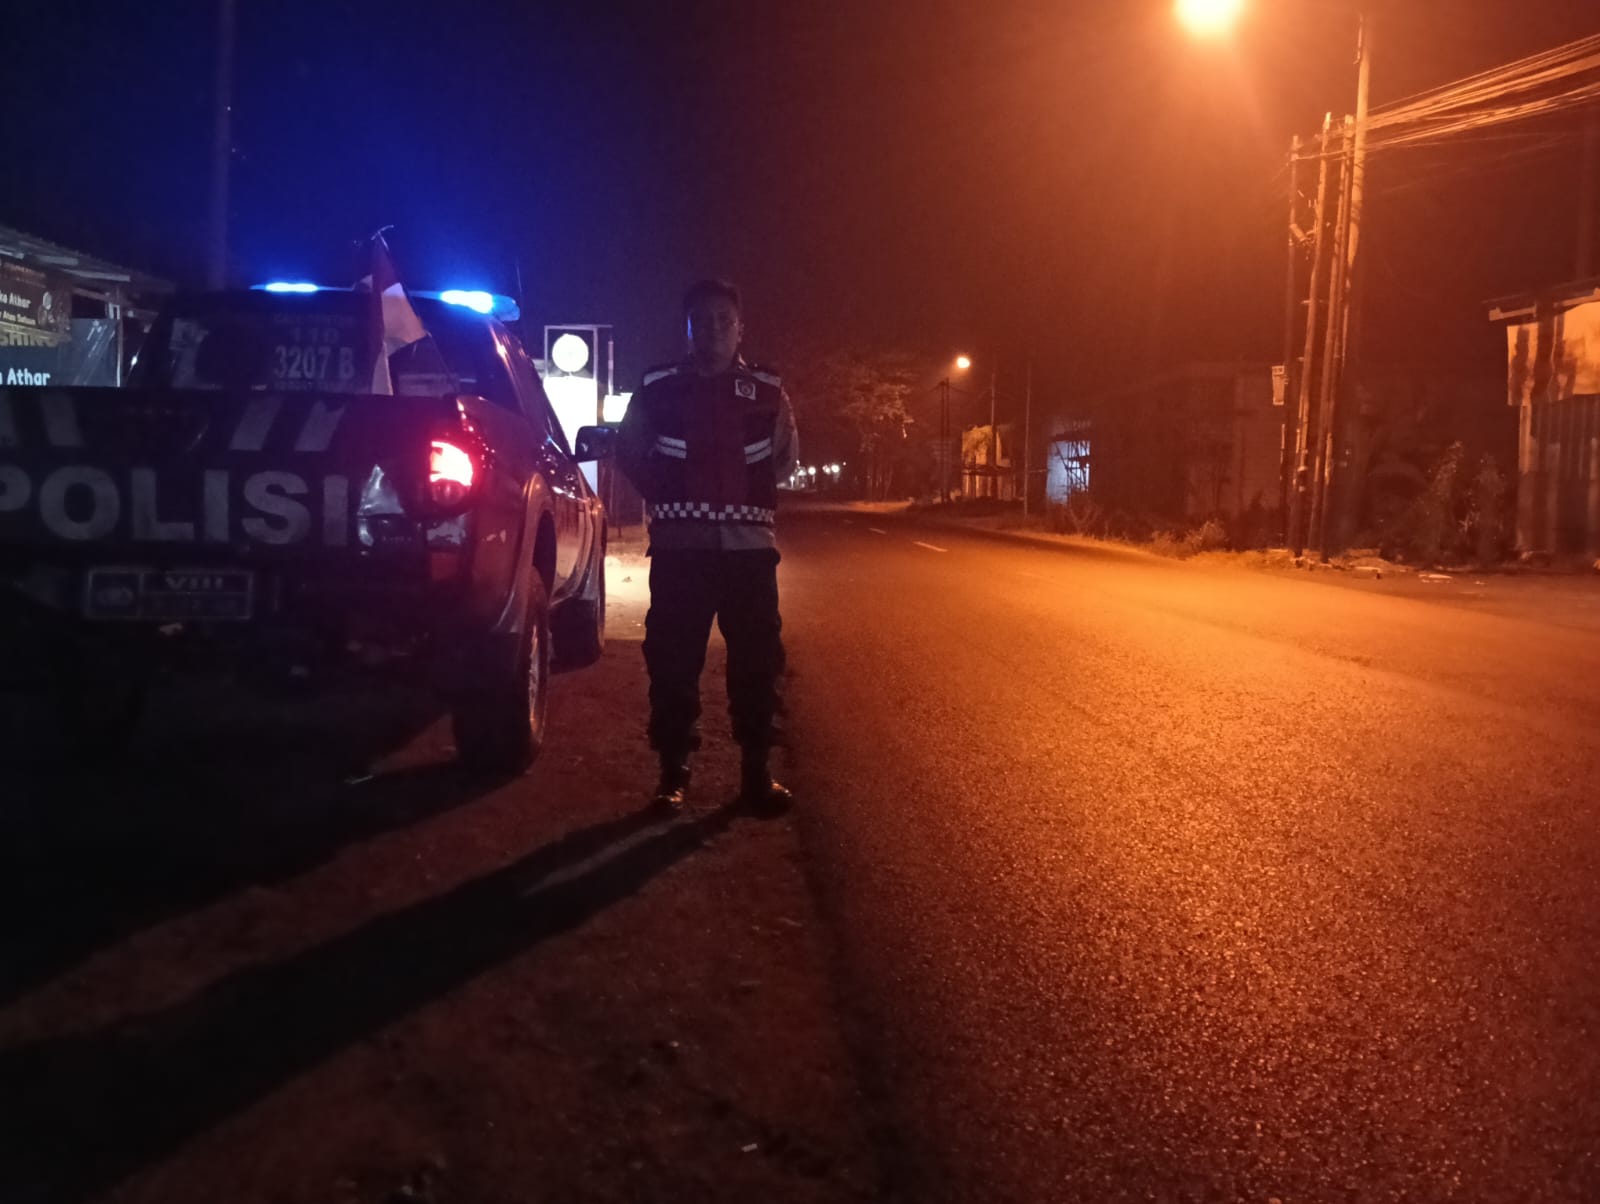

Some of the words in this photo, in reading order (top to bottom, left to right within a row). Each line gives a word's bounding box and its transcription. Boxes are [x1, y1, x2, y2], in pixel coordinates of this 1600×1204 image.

[273, 345, 331, 379] 3207
[339, 346, 355, 379] B
[6, 367, 51, 386] Athar
[164, 575, 225, 589] VIII
